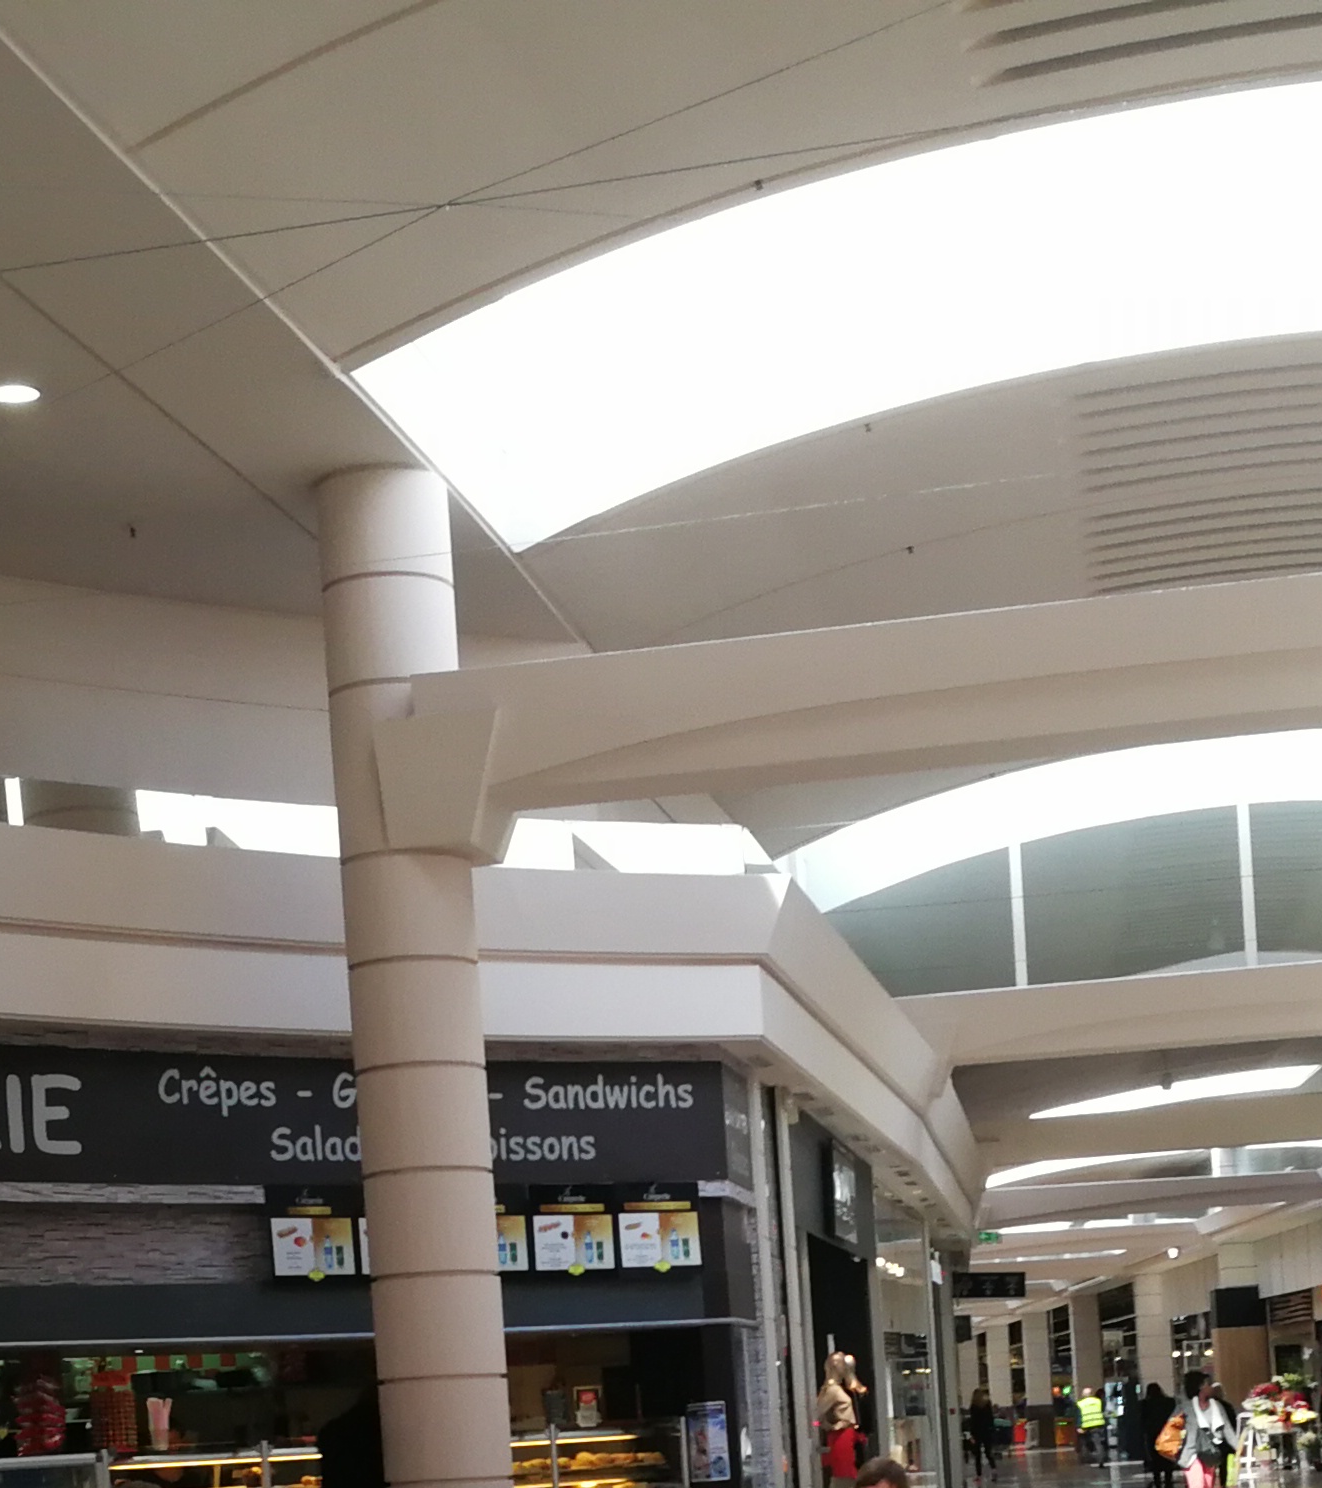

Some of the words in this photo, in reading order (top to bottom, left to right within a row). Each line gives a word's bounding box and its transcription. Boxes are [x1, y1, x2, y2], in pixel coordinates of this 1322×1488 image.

[158, 1066, 276, 1117] Crêpes
[523, 1073, 694, 1110] Sandwichs
[270, 1124, 361, 1161] Salad
